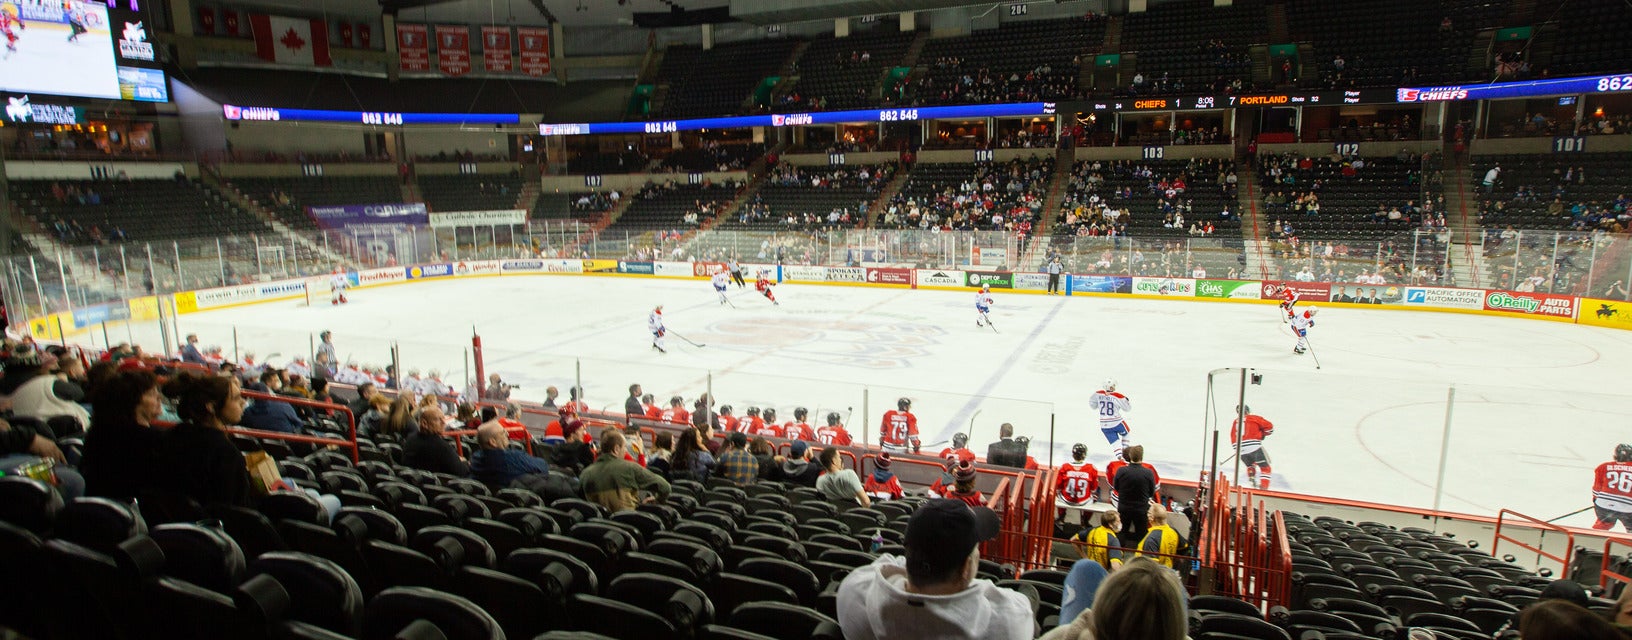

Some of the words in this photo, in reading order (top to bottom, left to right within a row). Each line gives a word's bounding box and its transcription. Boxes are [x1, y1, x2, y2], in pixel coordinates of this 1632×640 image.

[1597, 76, 1632, 91] 862
[1198, 96, 1213, 105] 8:09
[1229, 97, 1236, 106] 7
[1240, 96, 1288, 105] PORTLAND
[1419, 90, 1468, 102] CHIEFS
[1135, 100, 1166, 109] CHIEFS
[1175, 99, 1180, 108] 1
[880, 110, 898, 122] 862
[900, 109, 918, 121] 545
[1336, 144, 1359, 157] 102
[1556, 138, 1583, 152] 101
[829, 153, 845, 165] 105
[976, 150, 993, 162] 104
[1143, 147, 1163, 159] 103
[1136, 281, 1159, 292] CUTS
[1169, 282, 1191, 293] KIDS
[1202, 283, 1223, 293] CHAS
[1426, 289, 1454, 297] PACIFIC
[197, 291, 232, 301] Corwin
[236, 287, 256, 296] Ford
[1426, 295, 1477, 304] AUTOMATION
[1488, 292, 1540, 313] O'Reilly
[1544, 297, 1570, 307] AUTO
[1539, 304, 1572, 316] PARTS
[1099, 401, 1114, 416] 28
[1606, 471, 1632, 493] 26
[1065, 478, 1088, 499] 43
